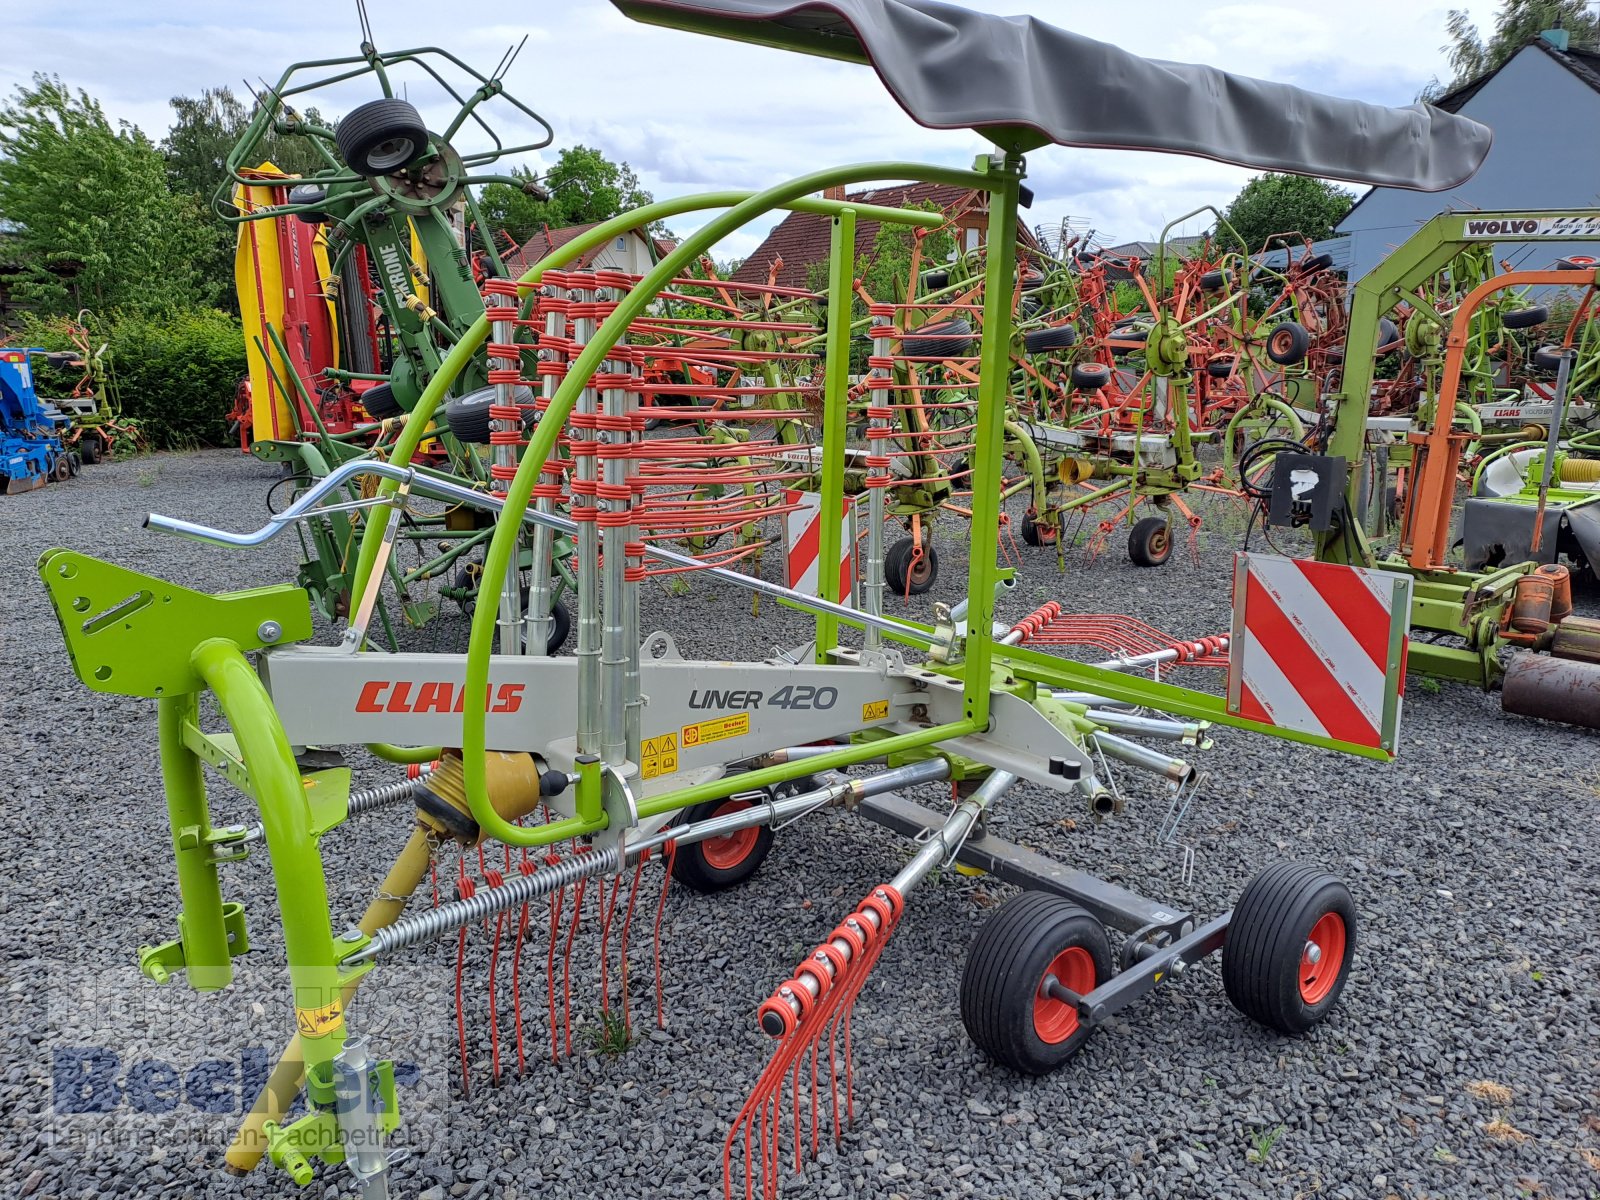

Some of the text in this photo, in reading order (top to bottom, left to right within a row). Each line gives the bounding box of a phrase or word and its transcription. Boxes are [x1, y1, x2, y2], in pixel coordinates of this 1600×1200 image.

[1468, 220, 1538, 235] WOLVO
[379, 243, 411, 295] KRONE
[1494, 409, 1521, 417] CLAAS
[688, 685, 839, 710] LINER 420
